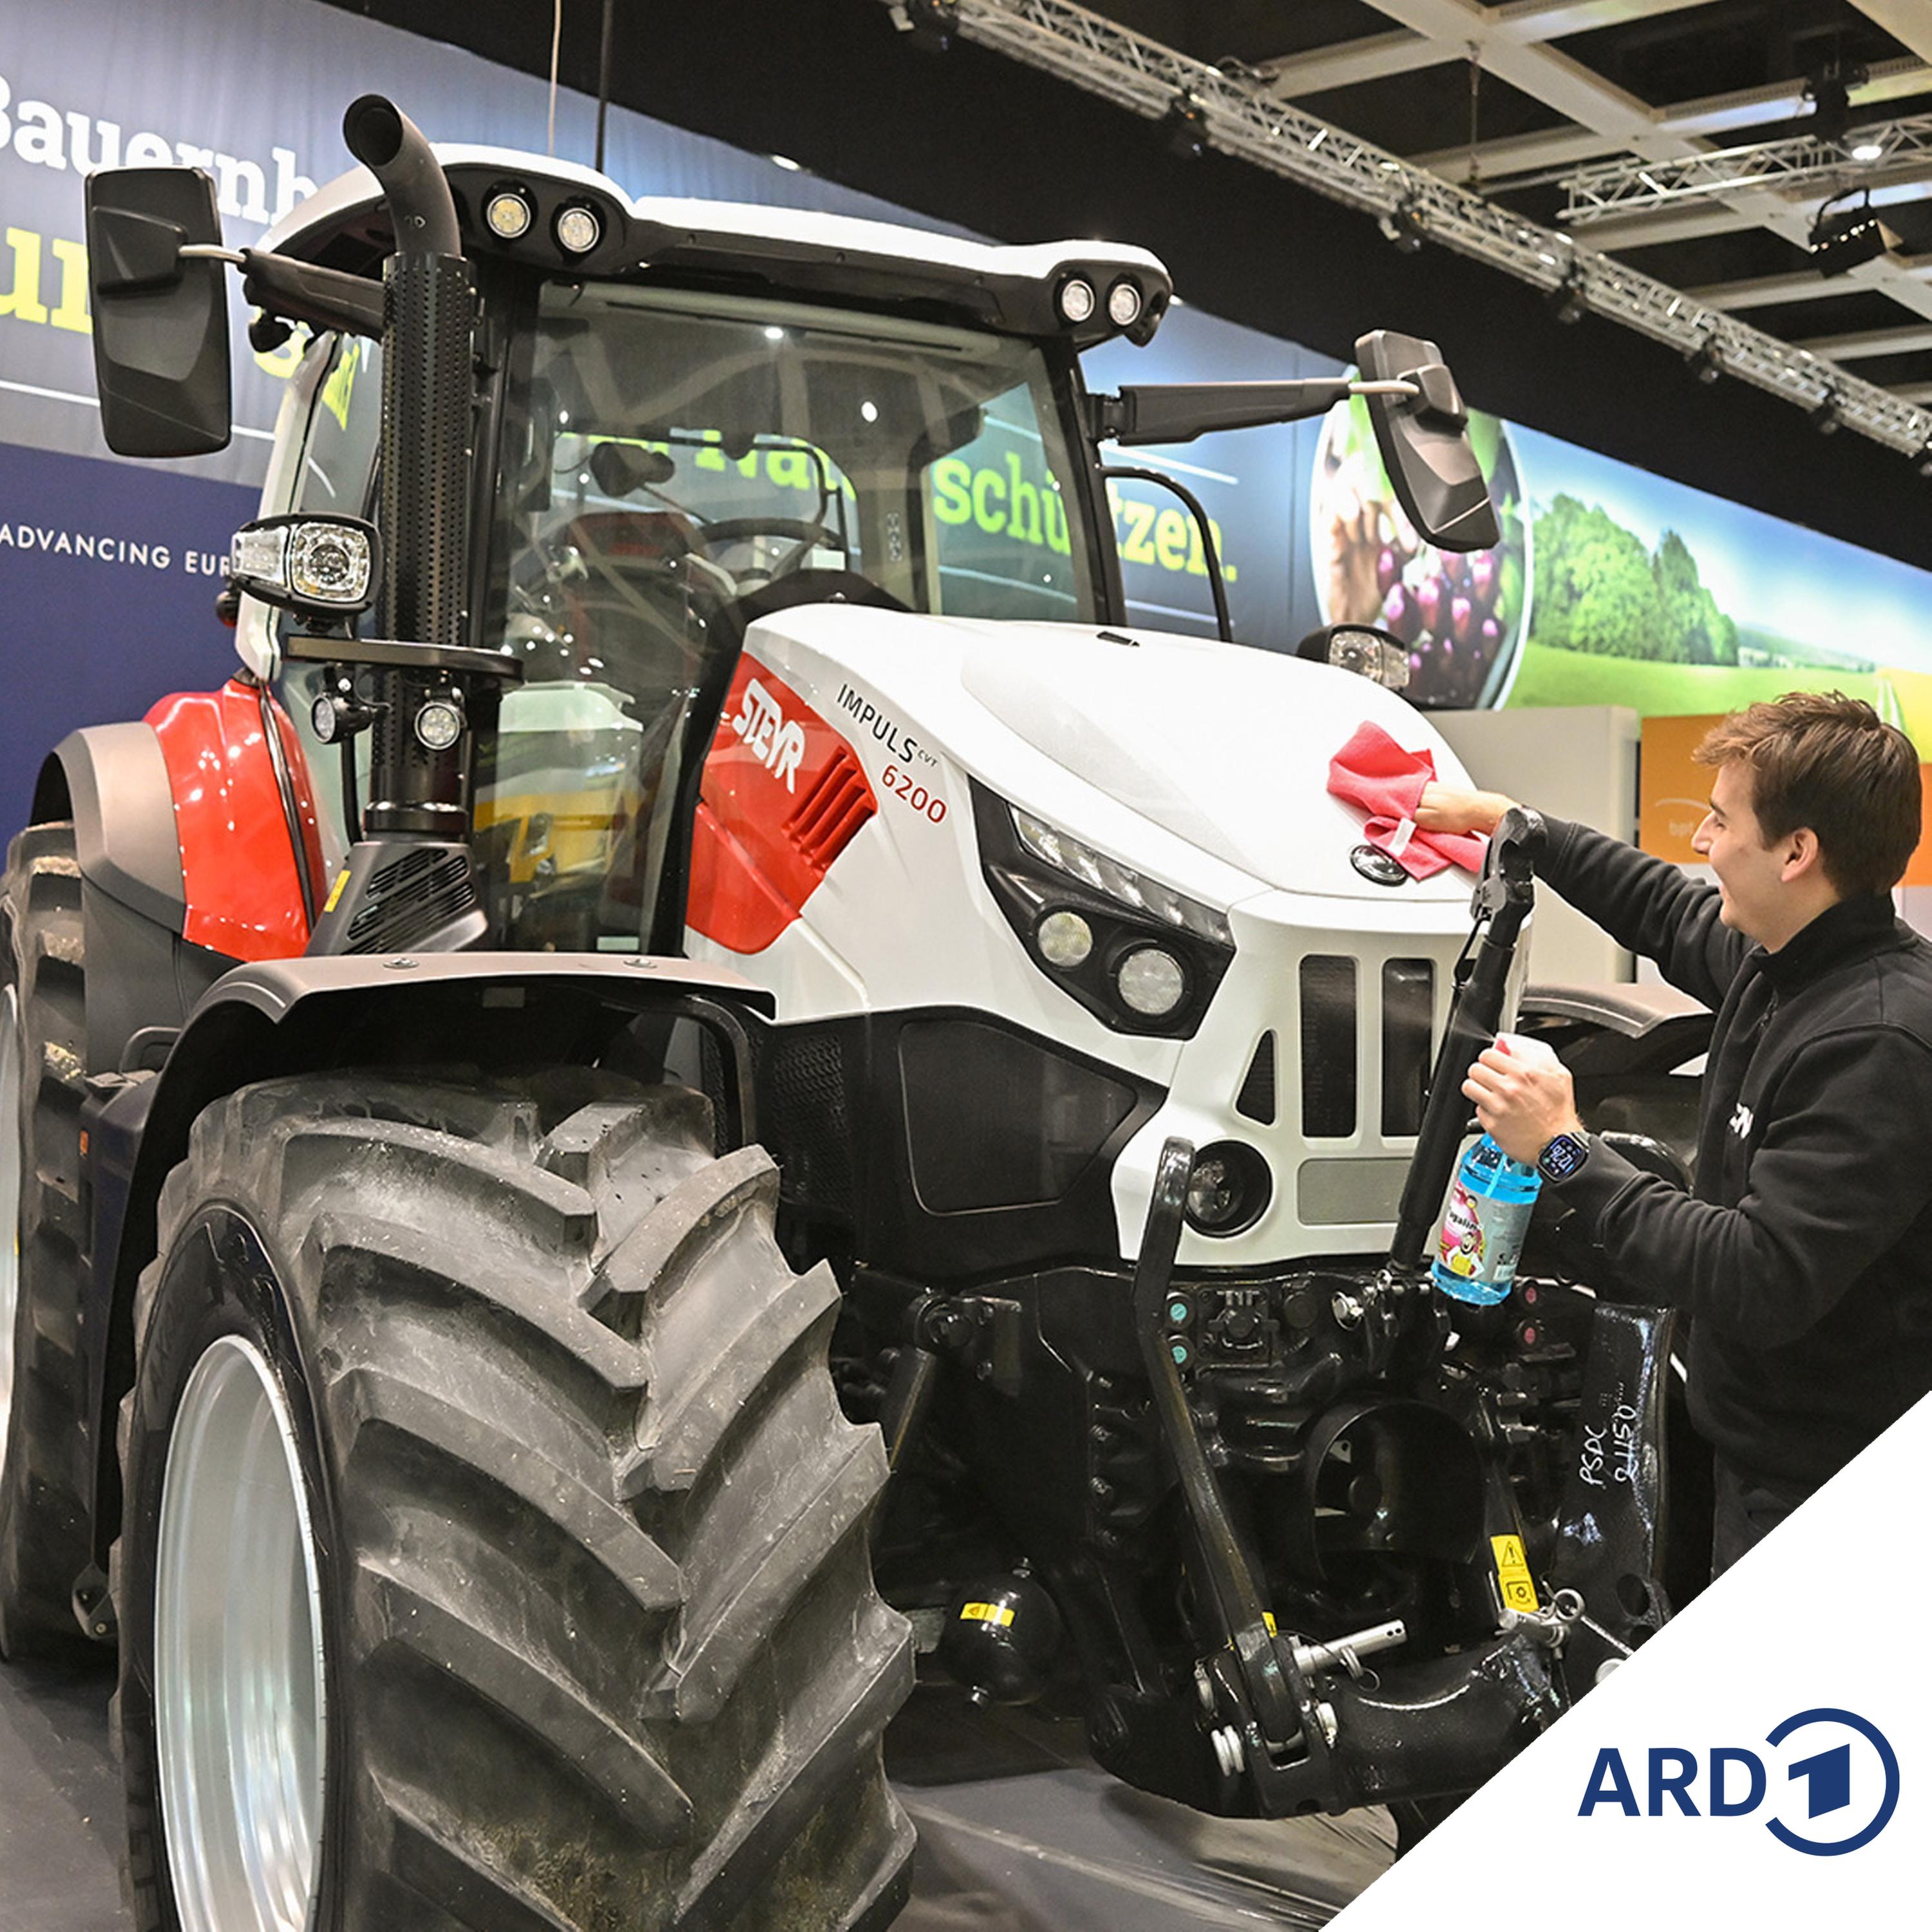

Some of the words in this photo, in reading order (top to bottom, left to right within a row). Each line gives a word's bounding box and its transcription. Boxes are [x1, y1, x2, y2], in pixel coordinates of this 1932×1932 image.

[0, 523, 171, 569] ADVANCING
[732, 677, 805, 793] STEYR
[837, 683, 918, 764] IMPULS
[917, 748, 938, 768] CVT
[882, 764, 947, 824] 6200
